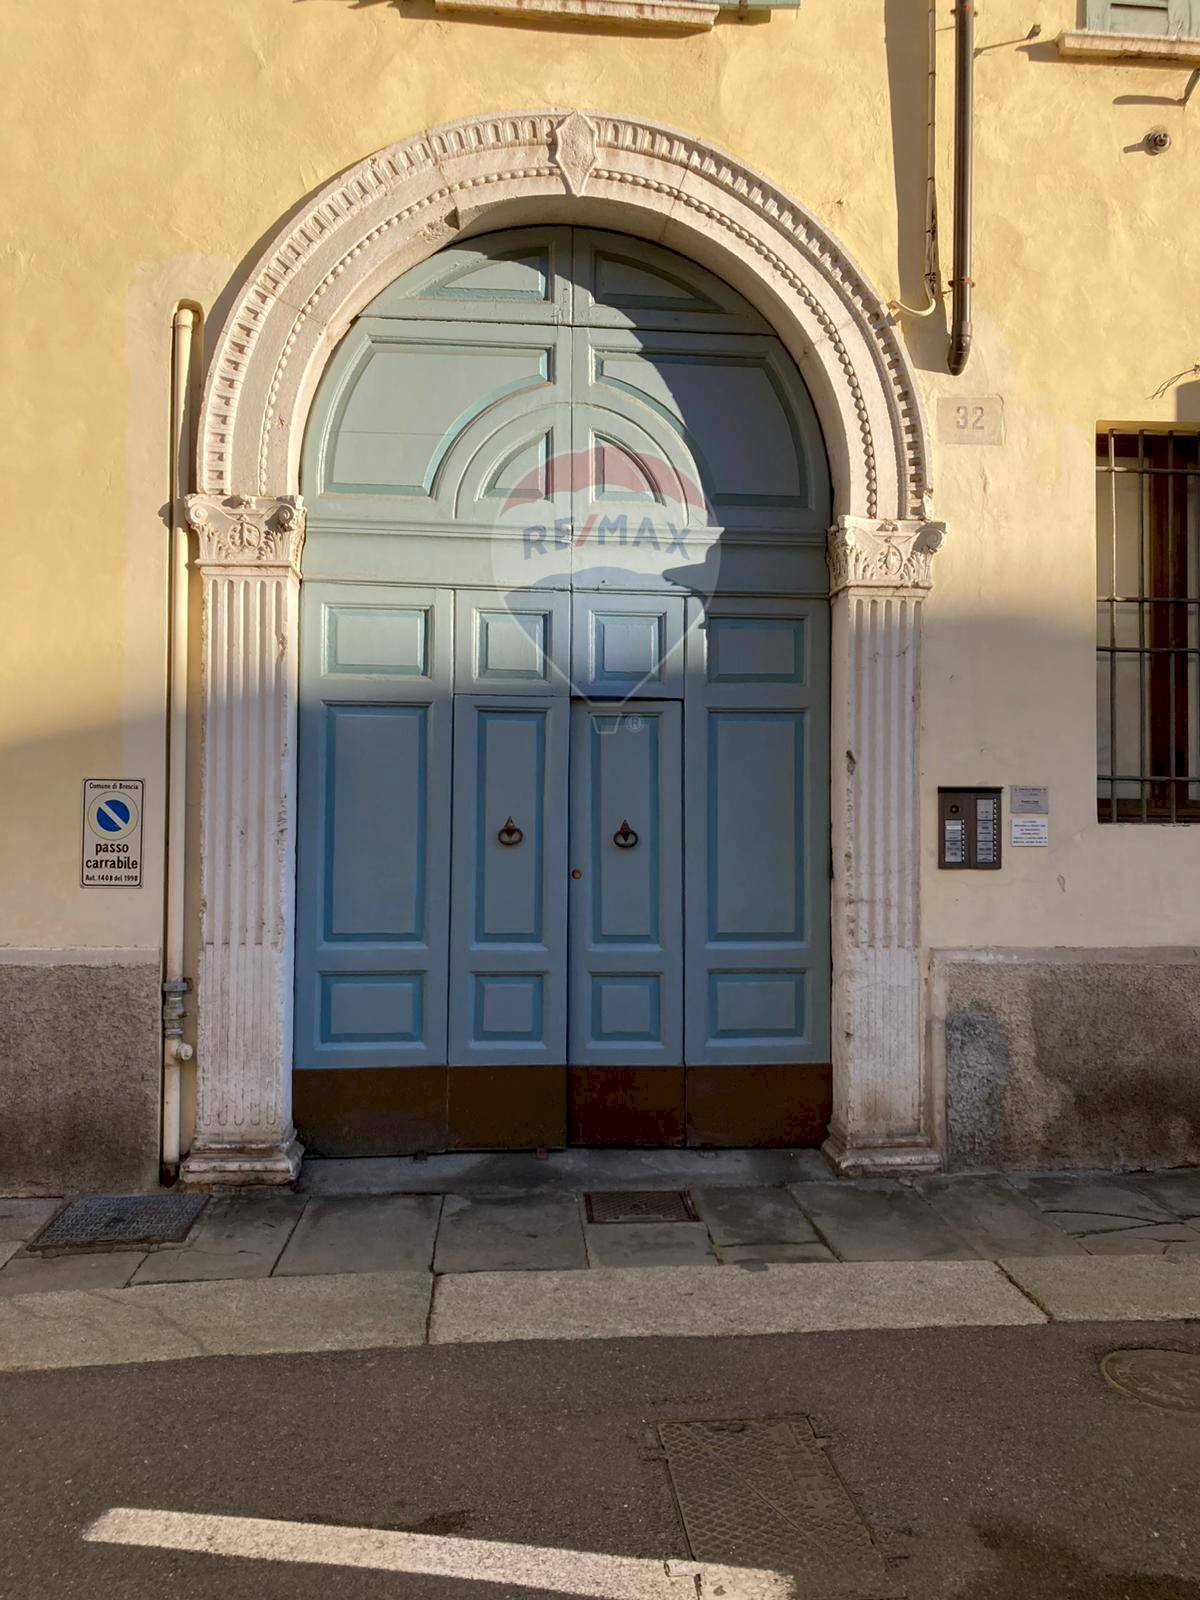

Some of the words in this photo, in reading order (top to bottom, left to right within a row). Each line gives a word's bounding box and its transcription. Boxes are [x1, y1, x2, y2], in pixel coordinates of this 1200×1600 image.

[956, 406, 984, 431] 32
[89, 782, 111, 790] Comune
[112, 782, 118, 790] di
[119, 782, 138, 790] Brescia
[95, 843, 129, 856] passo
[85, 856, 138, 869] carrabile
[114, 874, 123, 882] del
